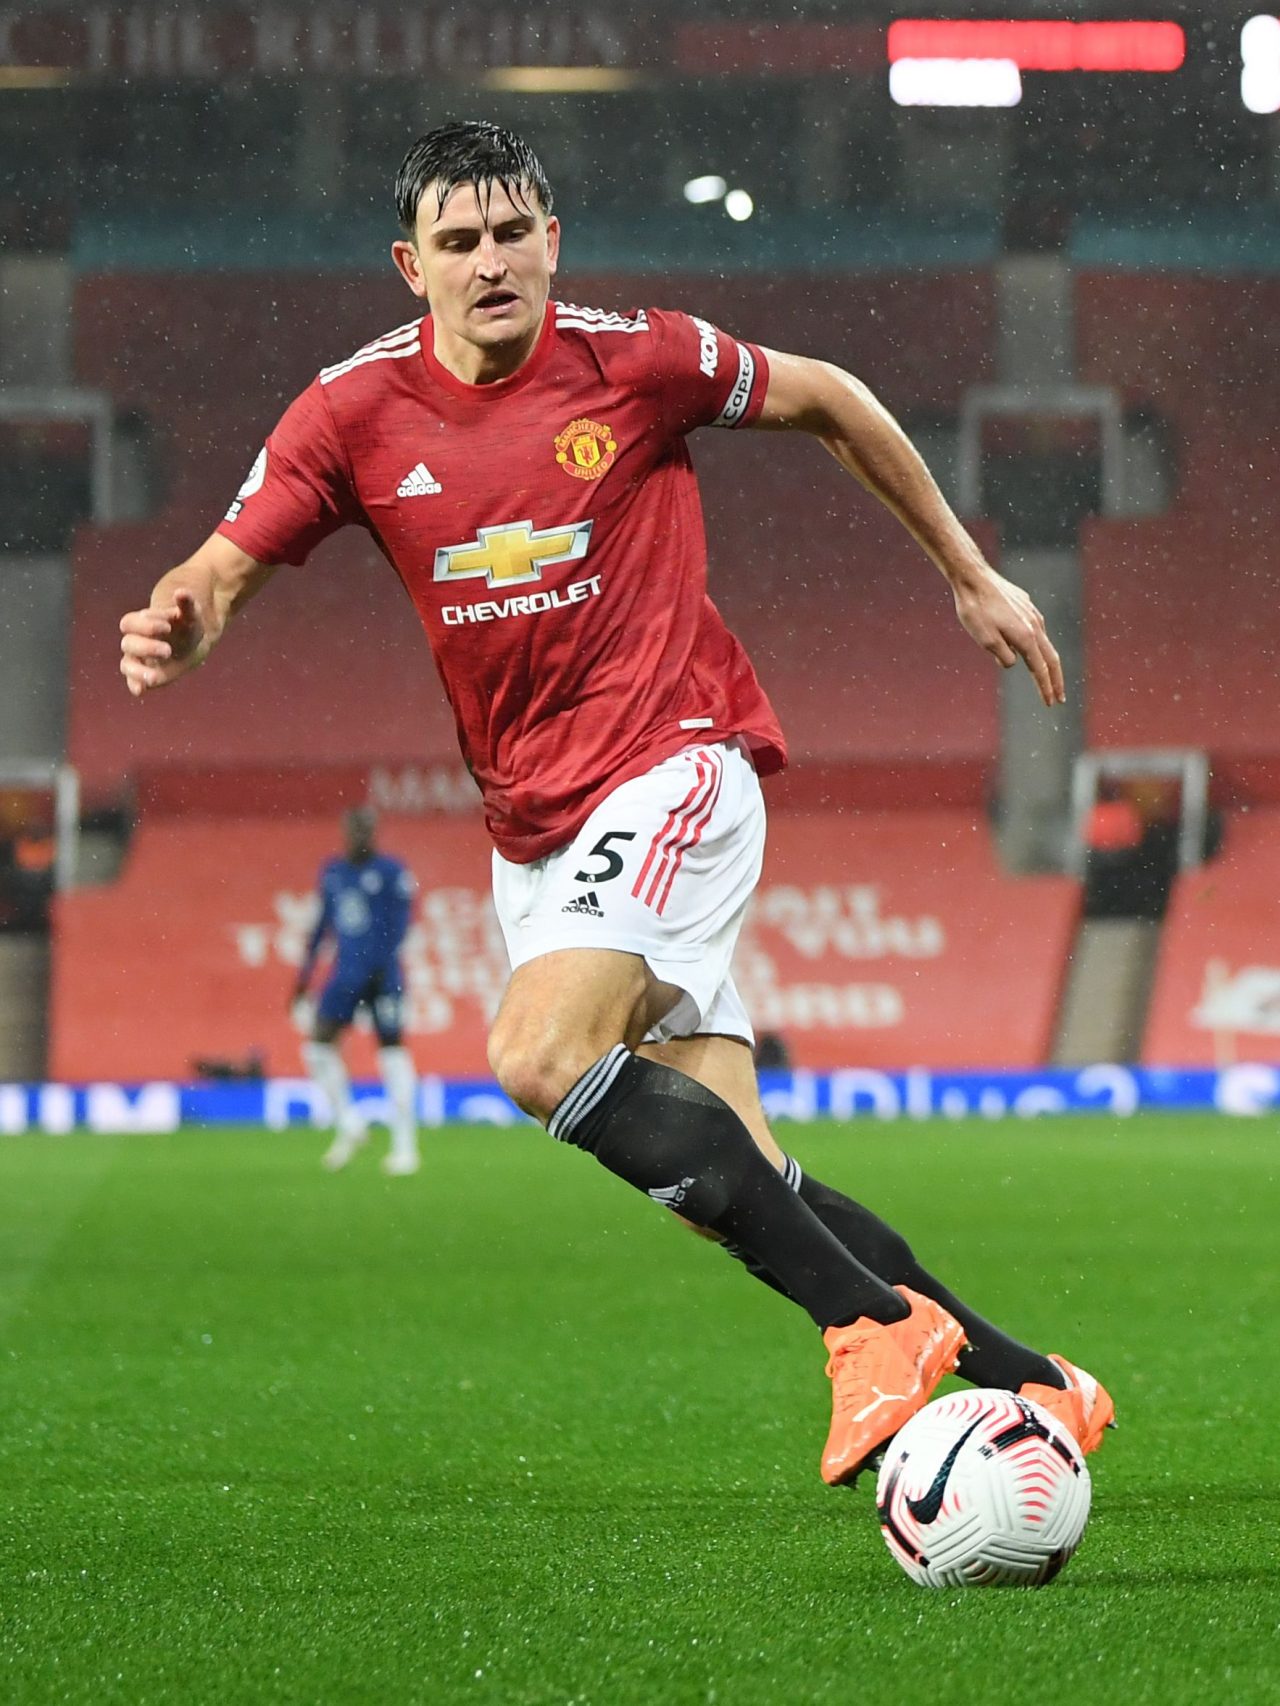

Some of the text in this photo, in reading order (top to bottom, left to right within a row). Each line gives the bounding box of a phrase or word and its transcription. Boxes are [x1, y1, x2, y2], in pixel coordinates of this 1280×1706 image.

[559, 422, 608, 447] MANCHESTER
[574, 460, 608, 477] UNITED
[396, 482, 443, 498] adidas
[441, 574, 602, 625] CHEVROLET
[574, 831, 637, 883] 5
[561, 904, 605, 918] adidas
